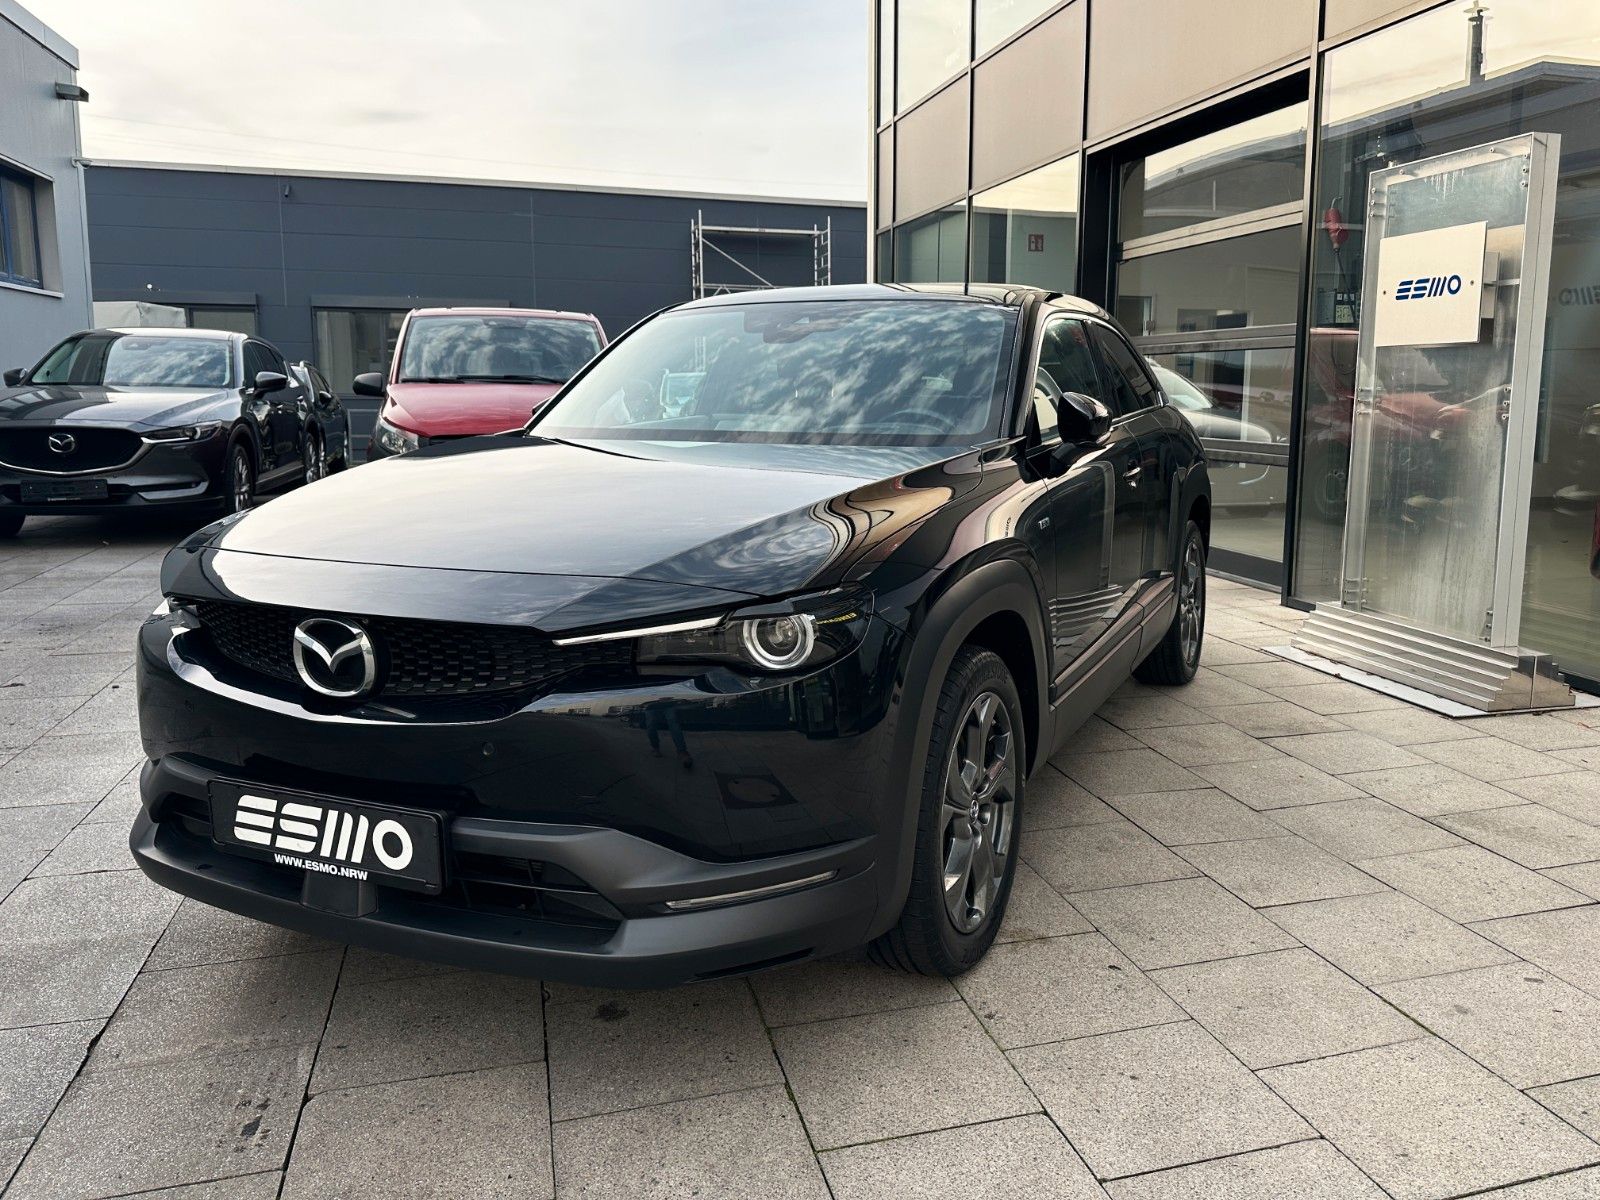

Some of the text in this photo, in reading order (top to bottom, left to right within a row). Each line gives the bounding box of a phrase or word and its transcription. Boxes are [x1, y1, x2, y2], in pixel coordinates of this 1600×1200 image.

[1395, 274, 1461, 301] ESMO
[233, 794, 413, 870] ESMO
[274, 853, 368, 881] WWW.ESMO.NRW
